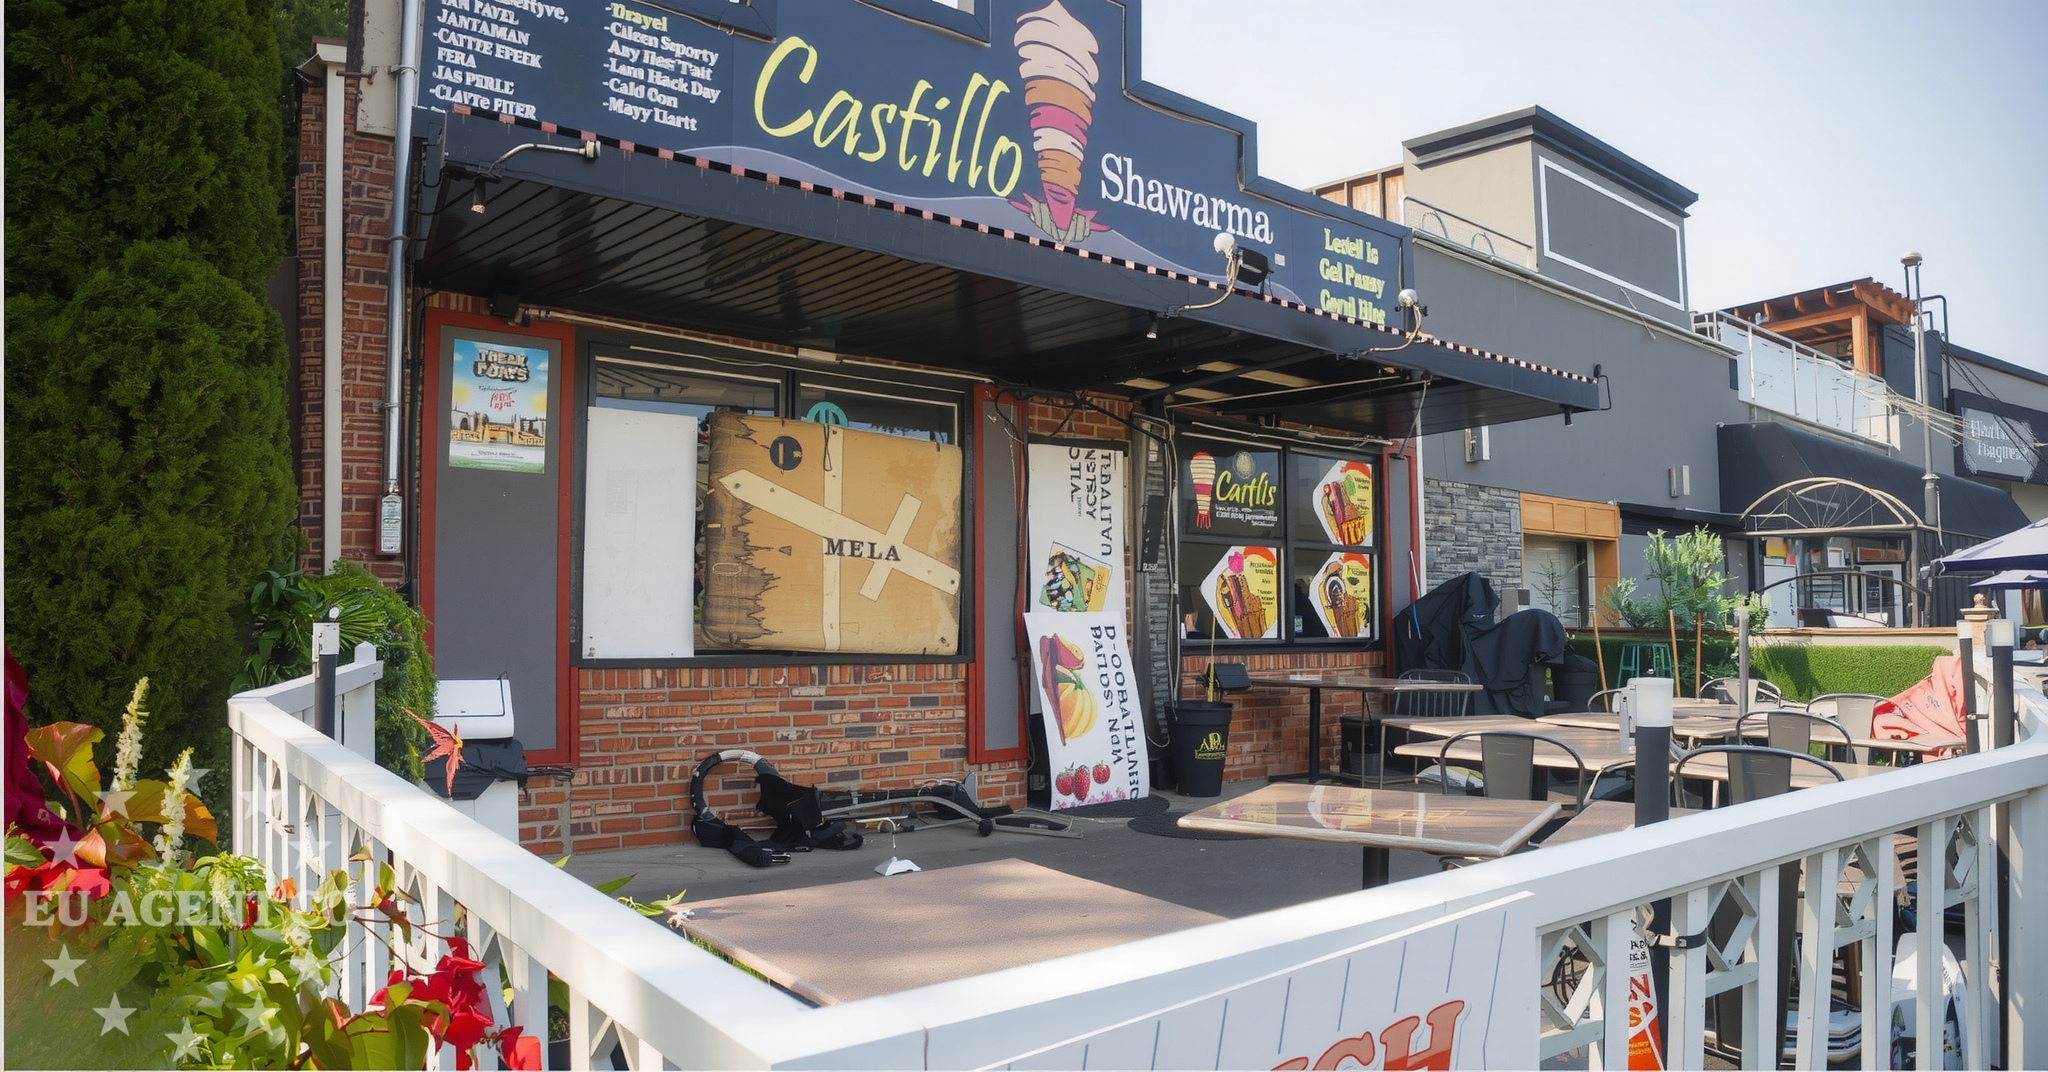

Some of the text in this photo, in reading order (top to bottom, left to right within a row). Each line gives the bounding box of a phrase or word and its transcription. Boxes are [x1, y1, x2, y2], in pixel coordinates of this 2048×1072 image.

[690, 81, 721, 104] Day
[754, 36, 1022, 197] Castillo
[1101, 152, 1275, 245] Shawarma
[824, 536, 902, 563] MELA
